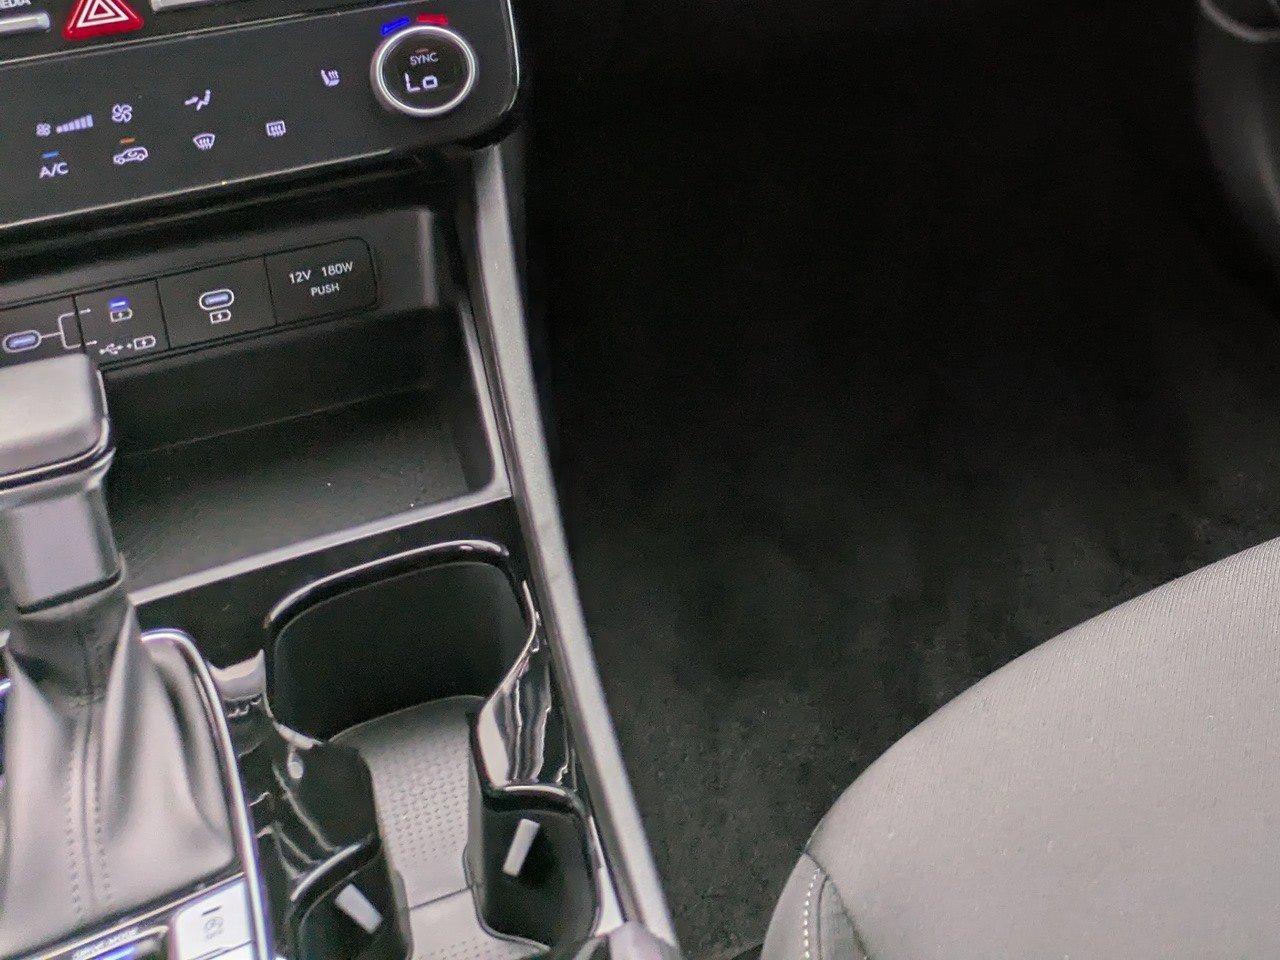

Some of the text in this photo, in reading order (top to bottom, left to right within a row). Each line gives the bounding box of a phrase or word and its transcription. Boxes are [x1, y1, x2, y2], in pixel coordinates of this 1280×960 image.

[409, 52, 439, 67] SYNC
[404, 72, 439, 94] Lo
[39, 161, 69, 180] A/C
[288, 269, 312, 285] 12V
[310, 282, 340, 297] PUSH
